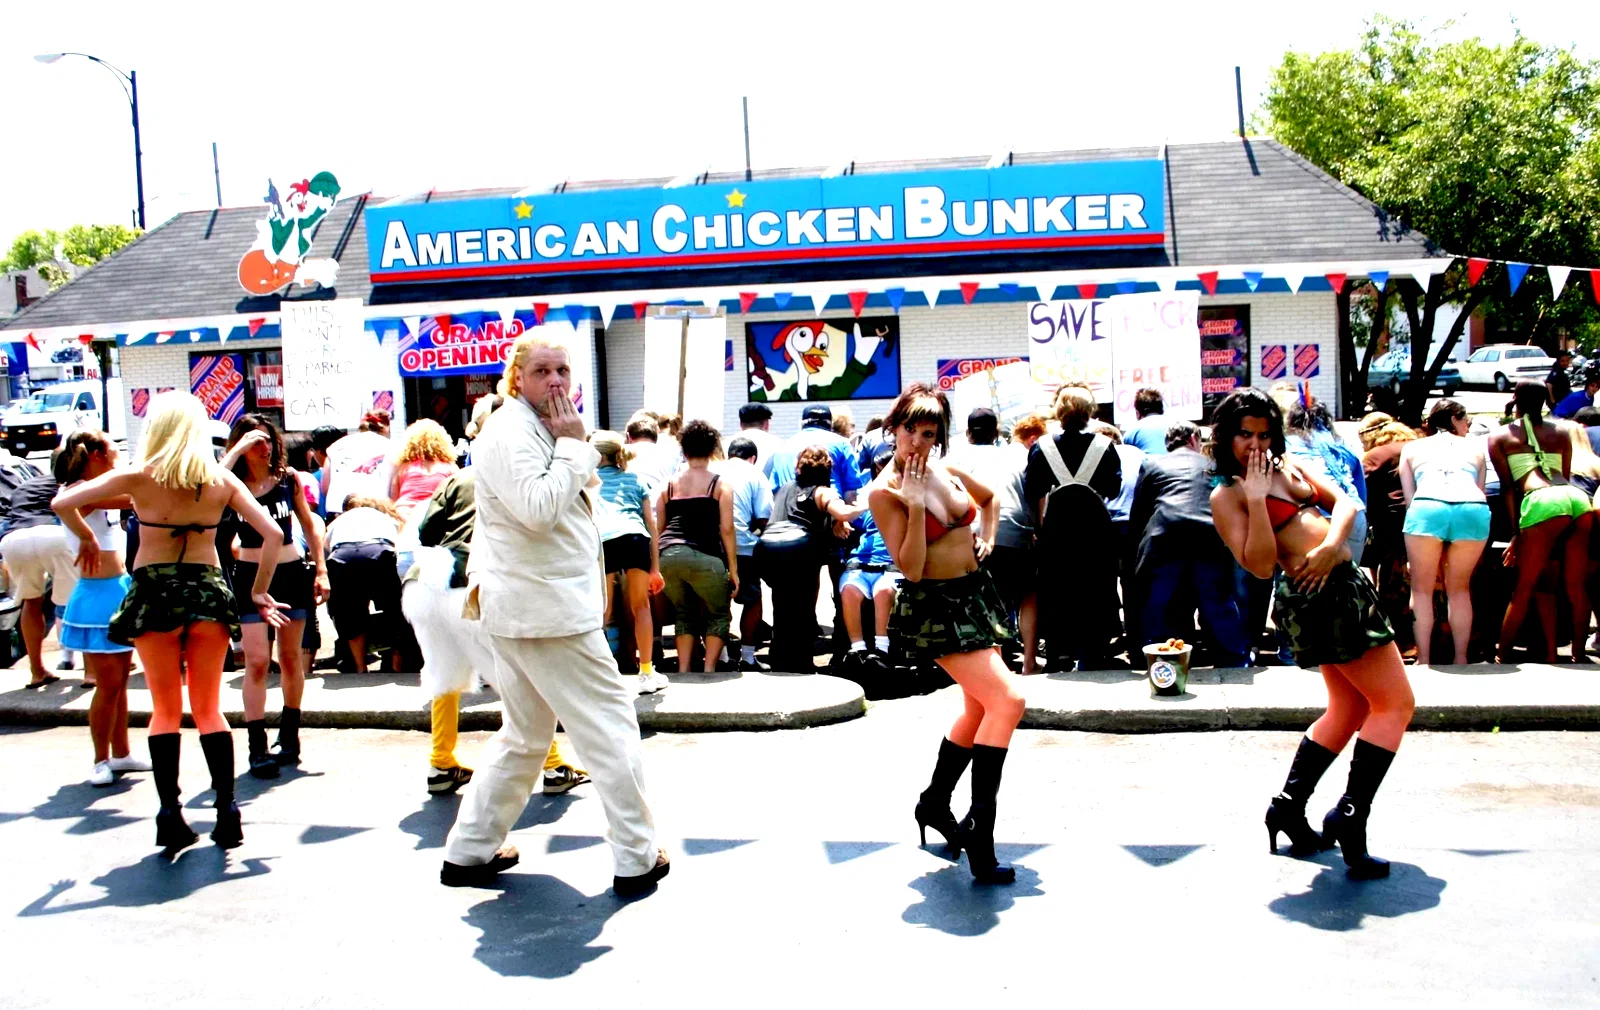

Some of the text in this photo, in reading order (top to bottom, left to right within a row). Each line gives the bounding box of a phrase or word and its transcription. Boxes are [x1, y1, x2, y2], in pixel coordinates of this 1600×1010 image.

[380, 185, 1150, 269] AMERICAN CHICKEN BUNKER
[430, 318, 526, 347] GRAND
[1030, 300, 1107, 345] SAVE
[257, 385, 284, 400] HIRING
[260, 373, 279, 386] NOW
